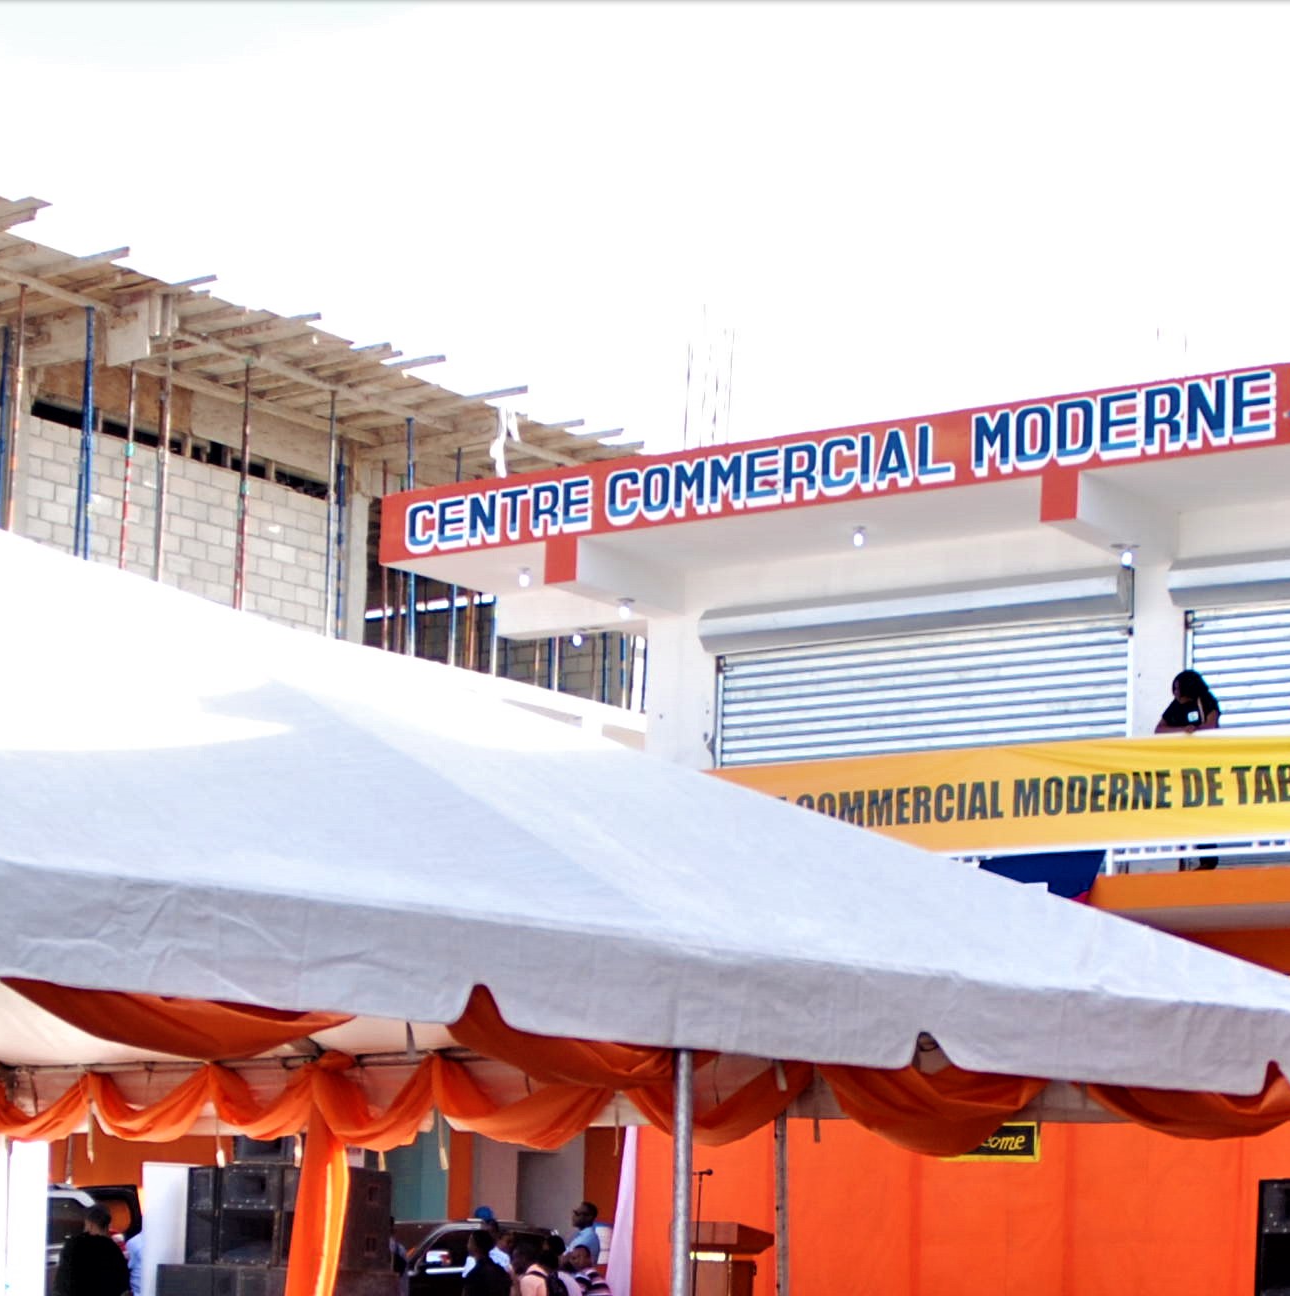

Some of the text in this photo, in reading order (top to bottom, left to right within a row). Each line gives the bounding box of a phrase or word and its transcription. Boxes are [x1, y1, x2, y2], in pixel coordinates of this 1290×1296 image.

[405, 478, 593, 555] CENTRE
[606, 424, 954, 527] COMMERCIAL
[972, 372, 1276, 477] MODERNE
[1012, 770, 1173, 818] MODERNE
[1181, 765, 1224, 807] DE
